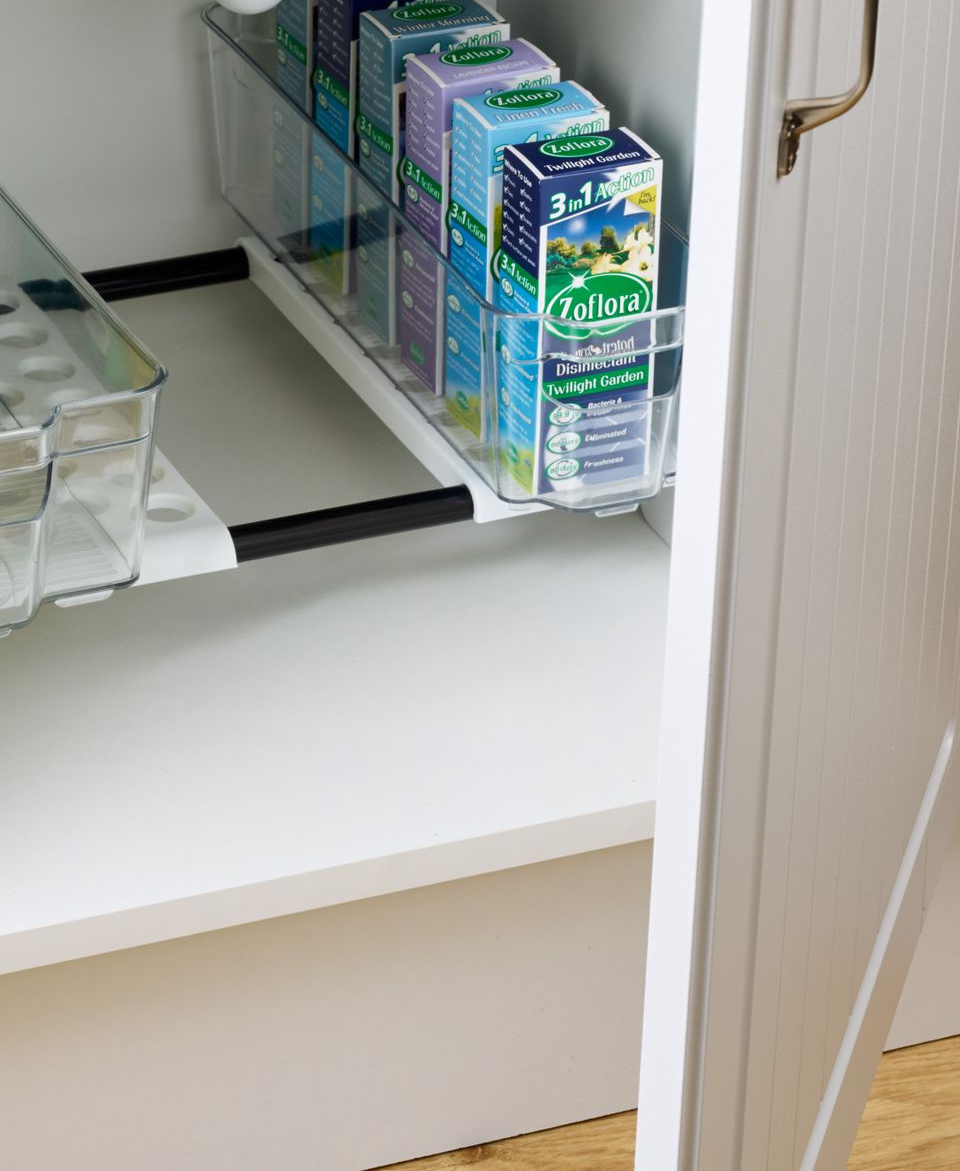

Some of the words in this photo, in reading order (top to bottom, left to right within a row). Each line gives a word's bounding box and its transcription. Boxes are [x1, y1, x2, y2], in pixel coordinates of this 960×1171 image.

[400, 5, 456, 19] Zoflora
[392, 21, 435, 34] Winter
[437, 14, 490, 28] Morning
[448, 47, 504, 63] Zoflora
[452, 65, 497, 79] LAVENDER
[497, 59, 530, 72] ESCAPE
[493, 90, 555, 107] Zoflora
[495, 109, 539, 123] Linen
[540, 101, 585, 116] Fresh
[547, 137, 607, 154] Zoflora
[544, 158, 596, 172] Twilight
[596, 150, 641, 163] Garden
[420, 176, 440, 200] Action
[594, 167, 655, 203] Action
[466, 218, 486, 243] Action
[516, 270, 536, 295] Action
[559, 293, 640, 321] Zoflora
[547, 378, 597, 396] Twilight
[600, 371, 644, 387] Garden
[587, 399, 616, 409] Bacteria
